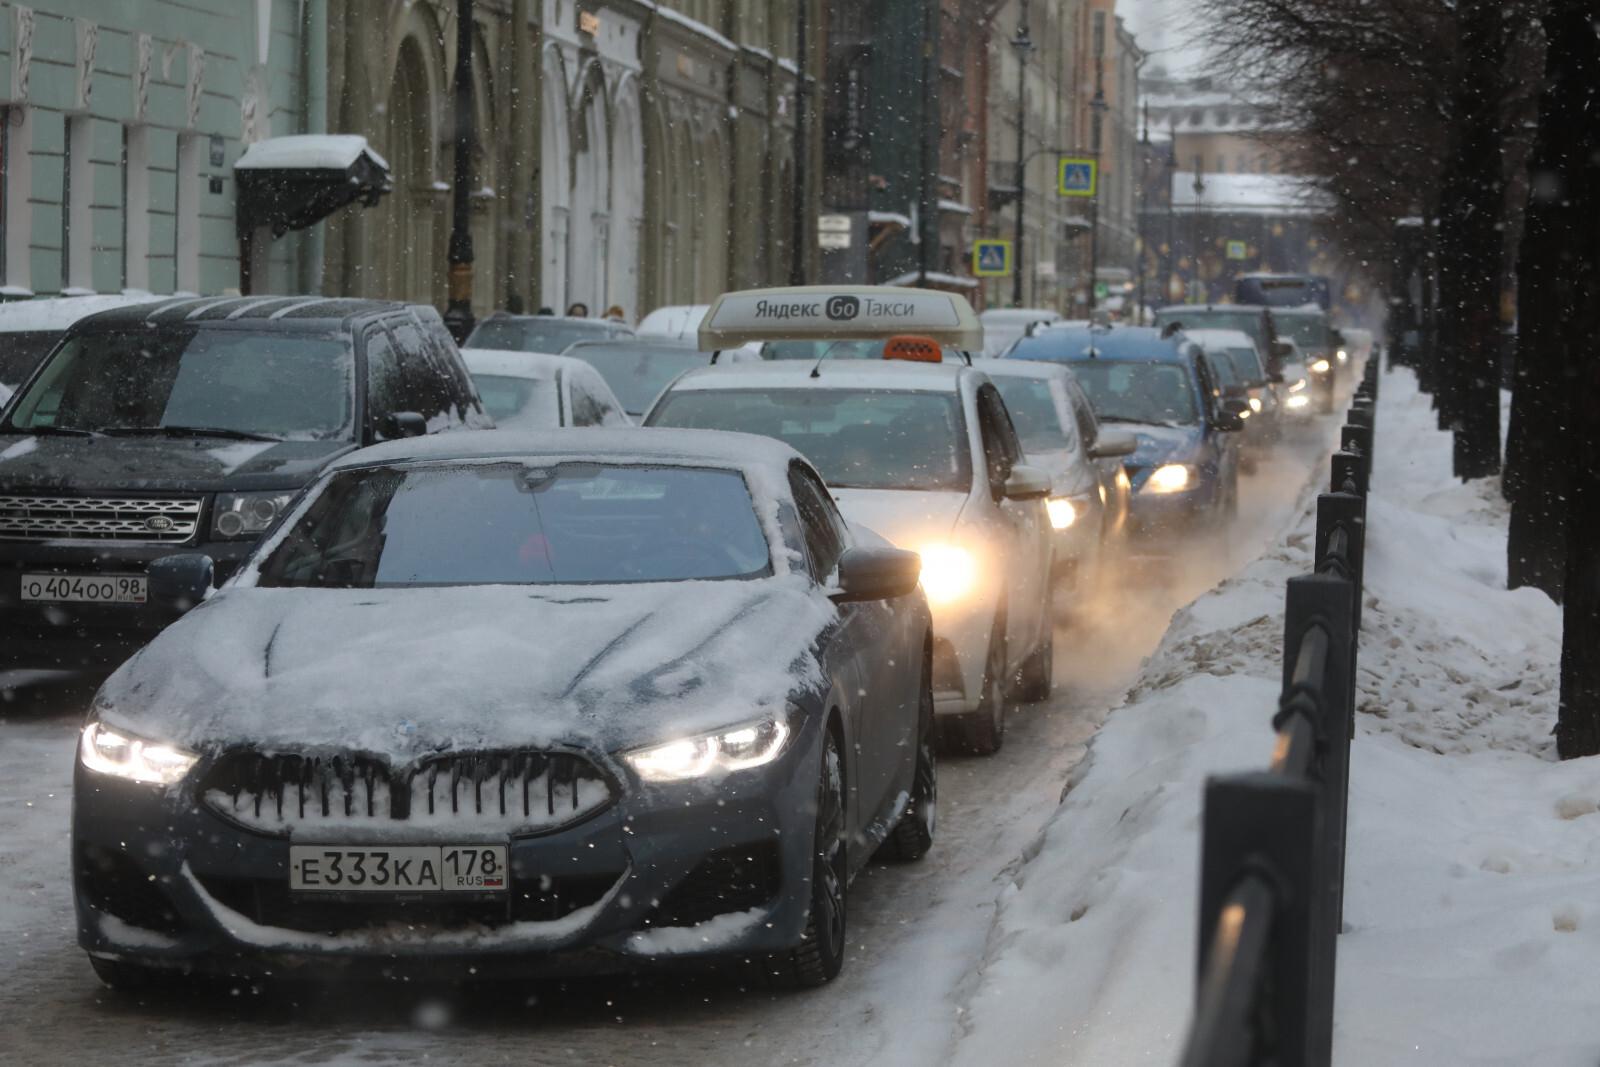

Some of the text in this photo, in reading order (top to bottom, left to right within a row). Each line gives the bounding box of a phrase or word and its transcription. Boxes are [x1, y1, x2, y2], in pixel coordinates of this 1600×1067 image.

[756, 298, 915, 319] Яндекс Go Такси
[119, 579, 140, 594] 98
[445, 850, 496, 876] 178
[457, 876, 484, 886] RUS
